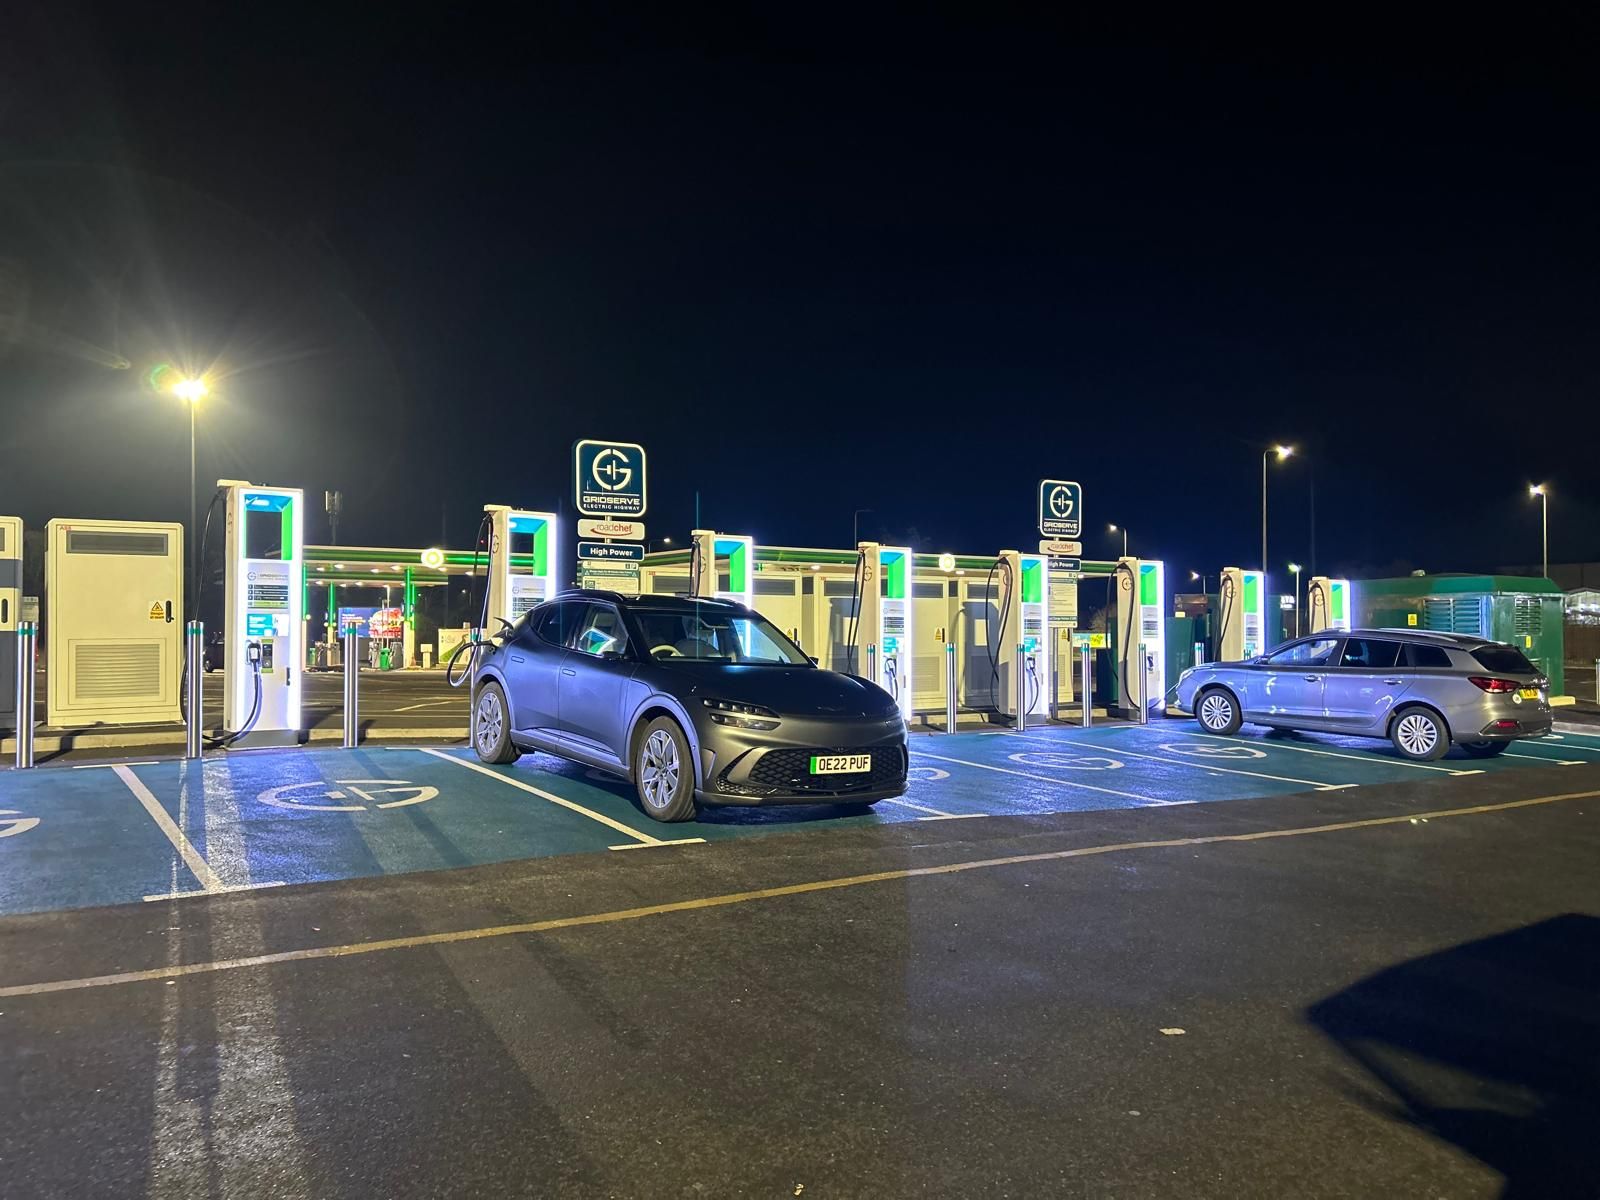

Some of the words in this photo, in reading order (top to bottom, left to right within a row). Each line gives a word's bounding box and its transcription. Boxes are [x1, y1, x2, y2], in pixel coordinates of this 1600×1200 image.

[583, 496, 640, 505] GRIDSERVE
[596, 523, 632, 533] roadchef
[590, 547, 608, 556] High
[609, 548, 633, 556] Power
[819, 757, 847, 771] OE22
[849, 756, 870, 770] PUF
